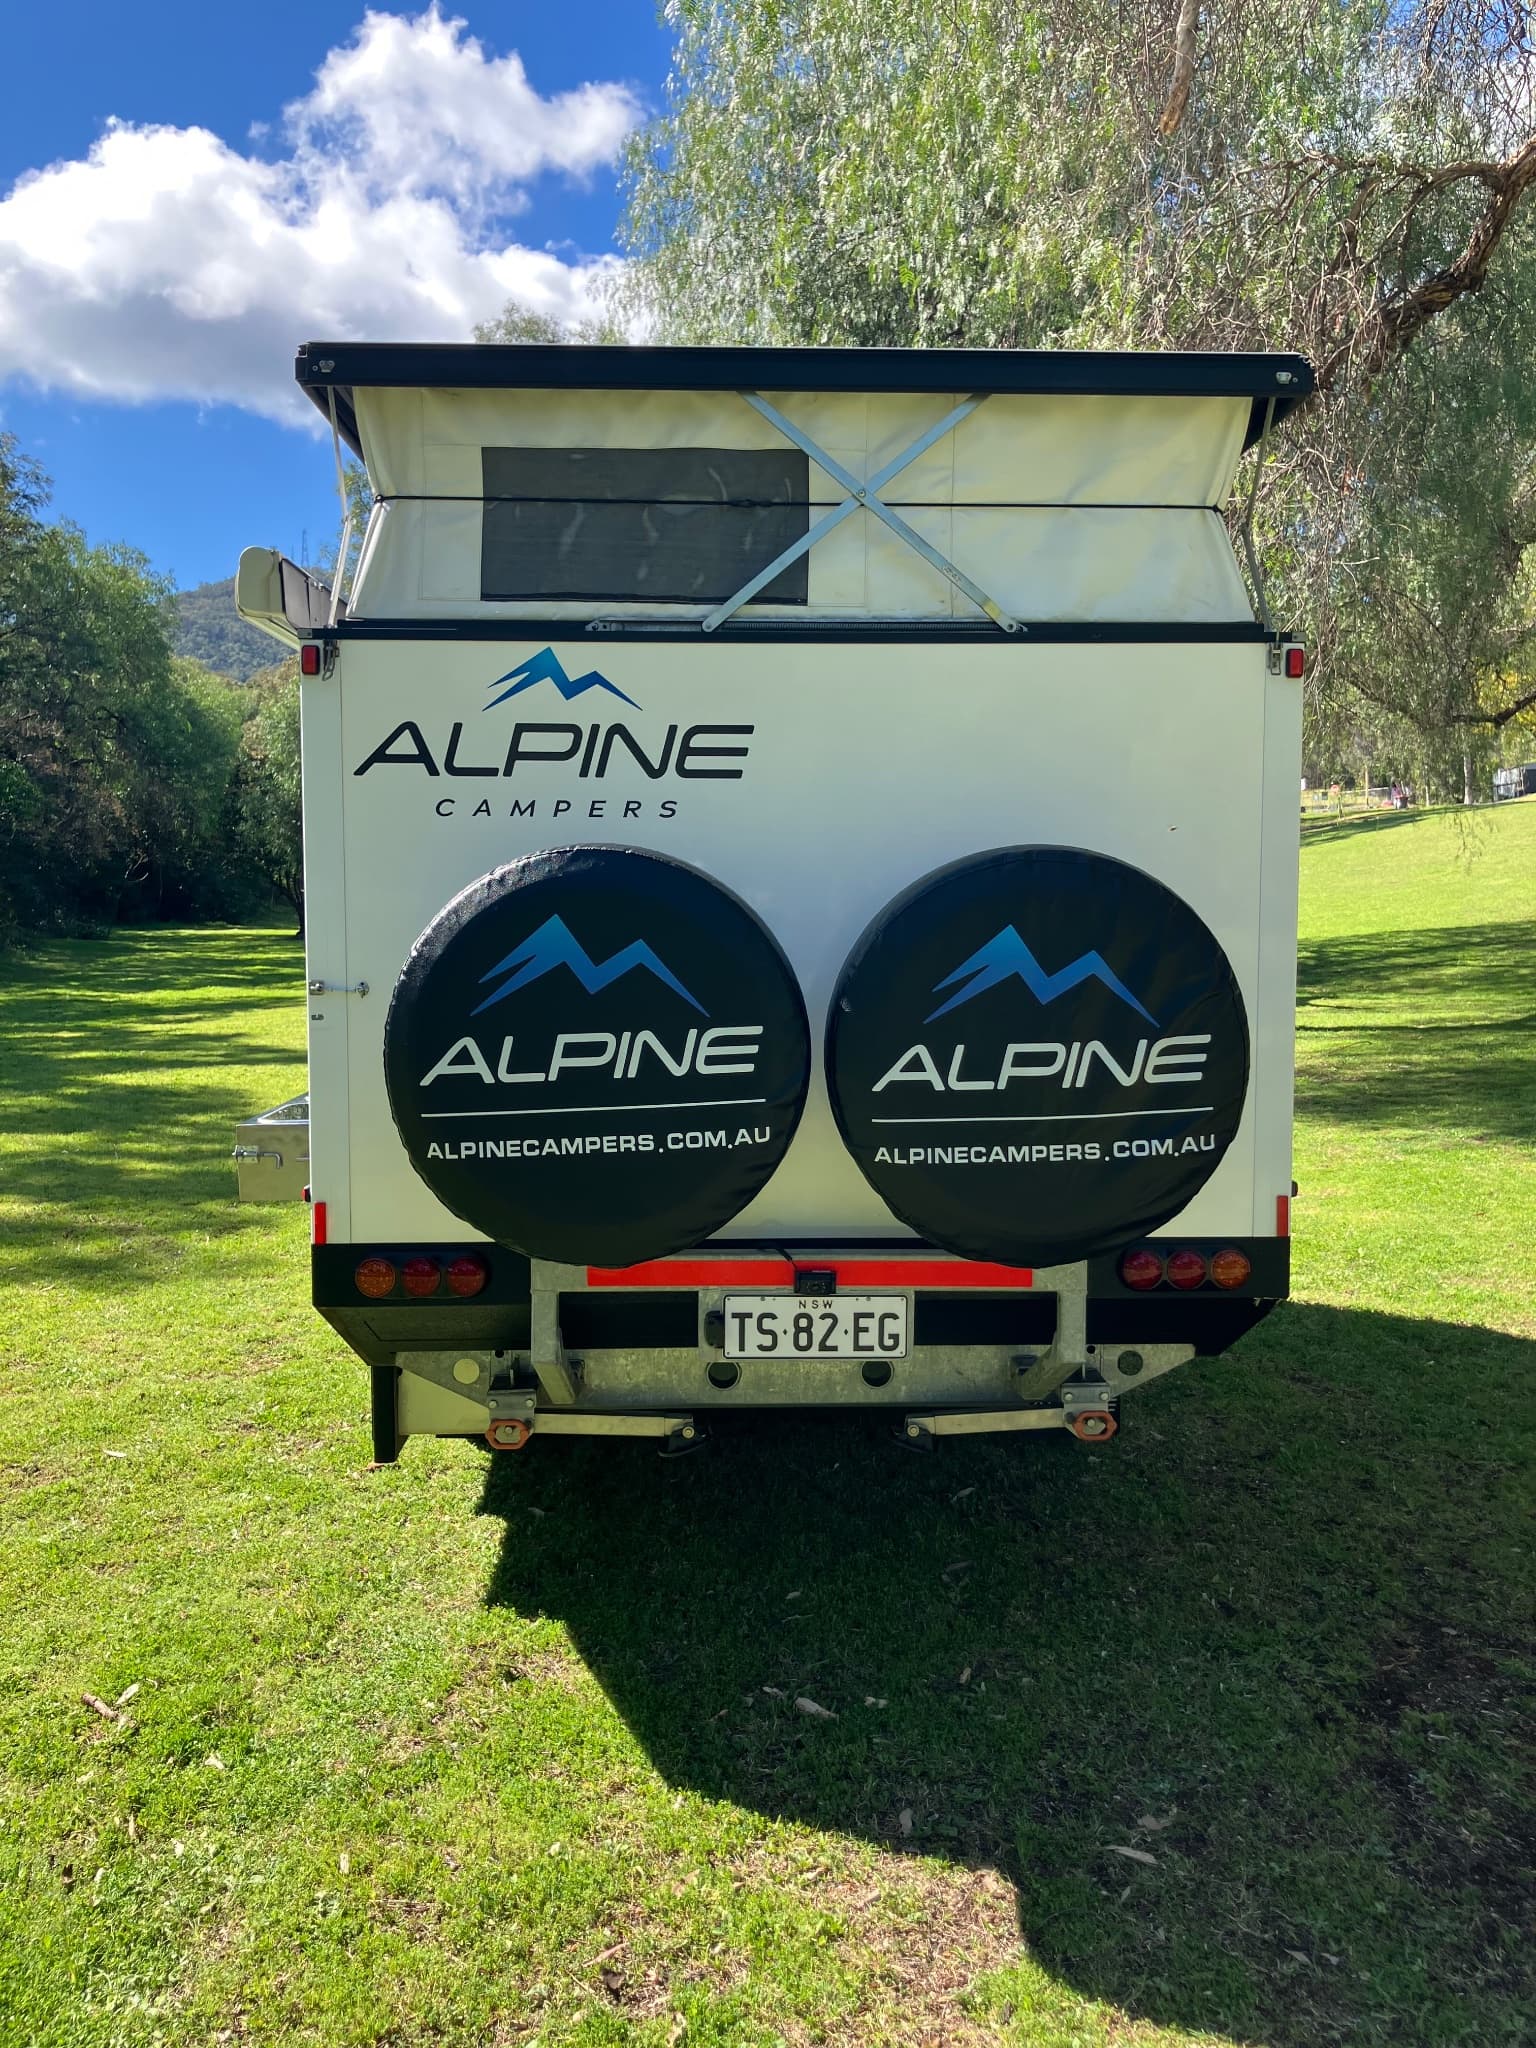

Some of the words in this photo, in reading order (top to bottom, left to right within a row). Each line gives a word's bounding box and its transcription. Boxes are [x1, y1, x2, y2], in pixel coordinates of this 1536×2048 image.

[354, 721, 755, 779] ALPINE
[436, 798, 679, 819] CAMPERS
[420, 1026, 764, 1086] ALPINE
[872, 1034, 1212, 1091] ALPINE
[427, 1127, 771, 1160] ALPINECAMPERS.COM.AU
[874, 1133, 1216, 1165] ALPINECAMPERS.COM.AU
[798, 1299, 833, 1310] NSW
